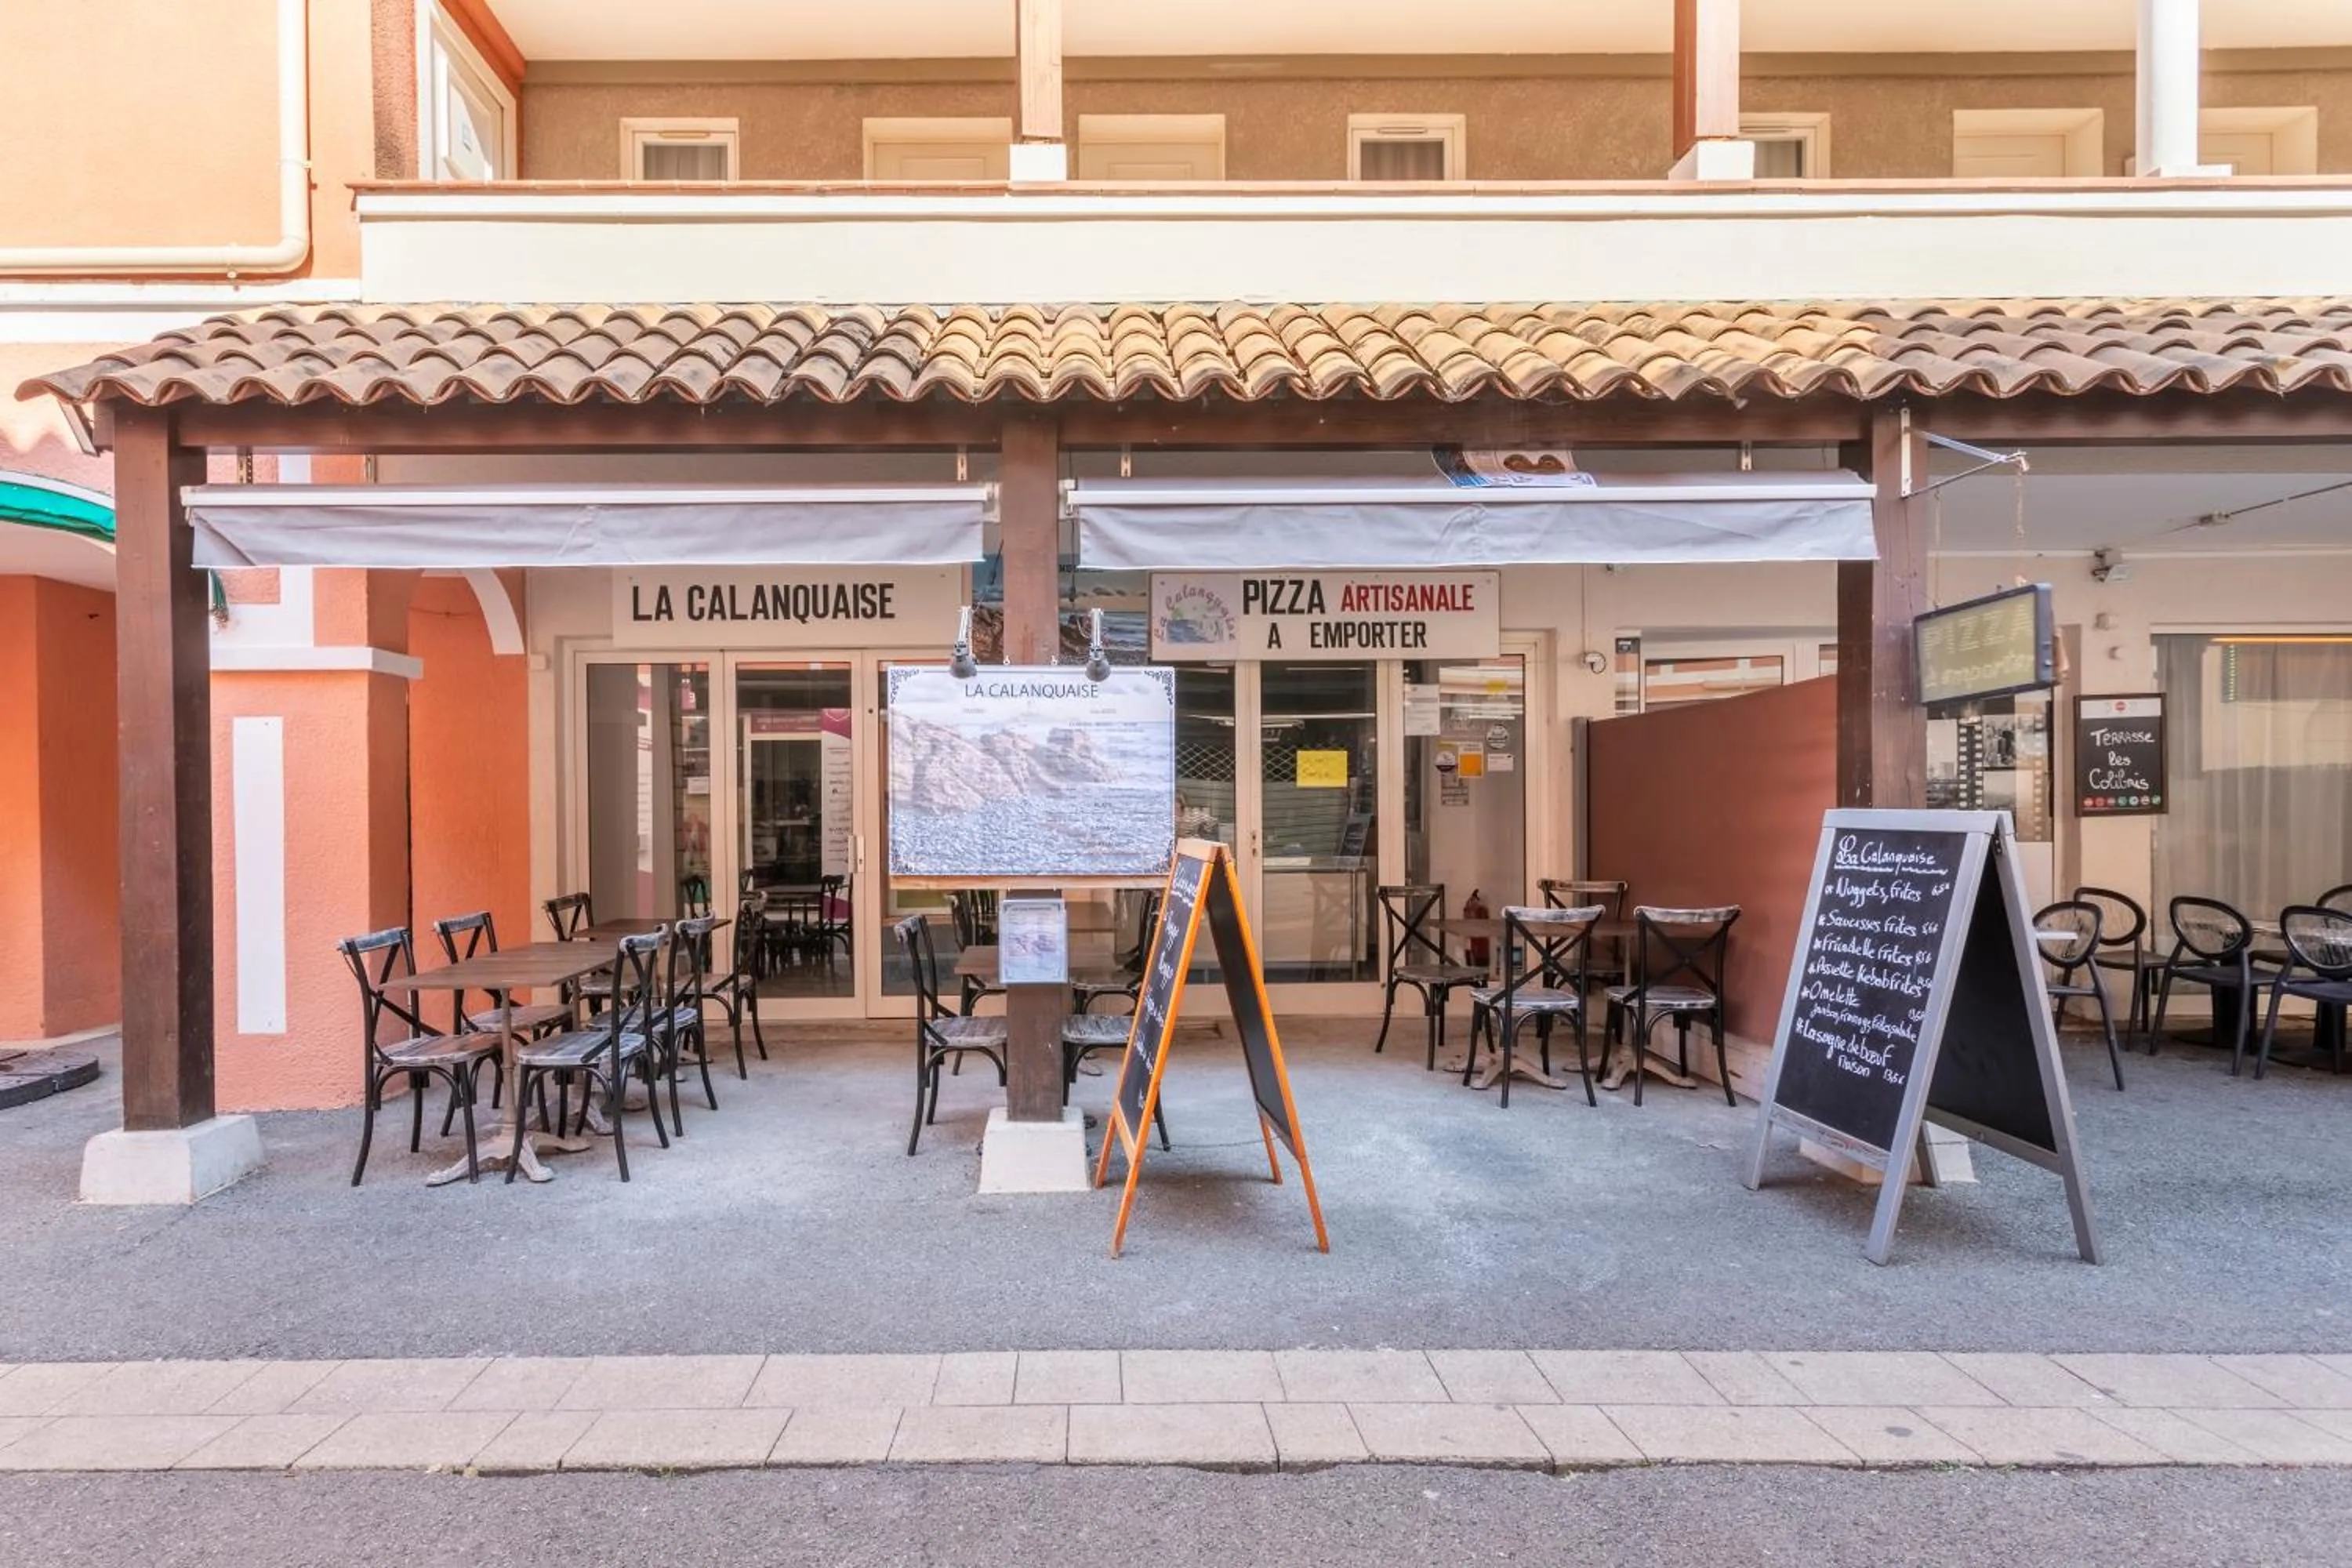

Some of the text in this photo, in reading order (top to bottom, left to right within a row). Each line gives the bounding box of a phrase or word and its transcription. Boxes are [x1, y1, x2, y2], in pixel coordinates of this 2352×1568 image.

[633, 583, 896, 624] LA CALANQUAISE
[1243, 579, 1475, 615] PIZZA ARTISANALE
[1267, 621, 1427, 650] A EMPORTER
[1922, 603, 2034, 660] PIZZA
[965, 683, 1099, 699] LA CALANQUAISE
[2089, 768, 2150, 789] Colibris
[1860, 840, 1936, 875] Calanquaise
[1809, 981, 1862, 1007] Omelette
